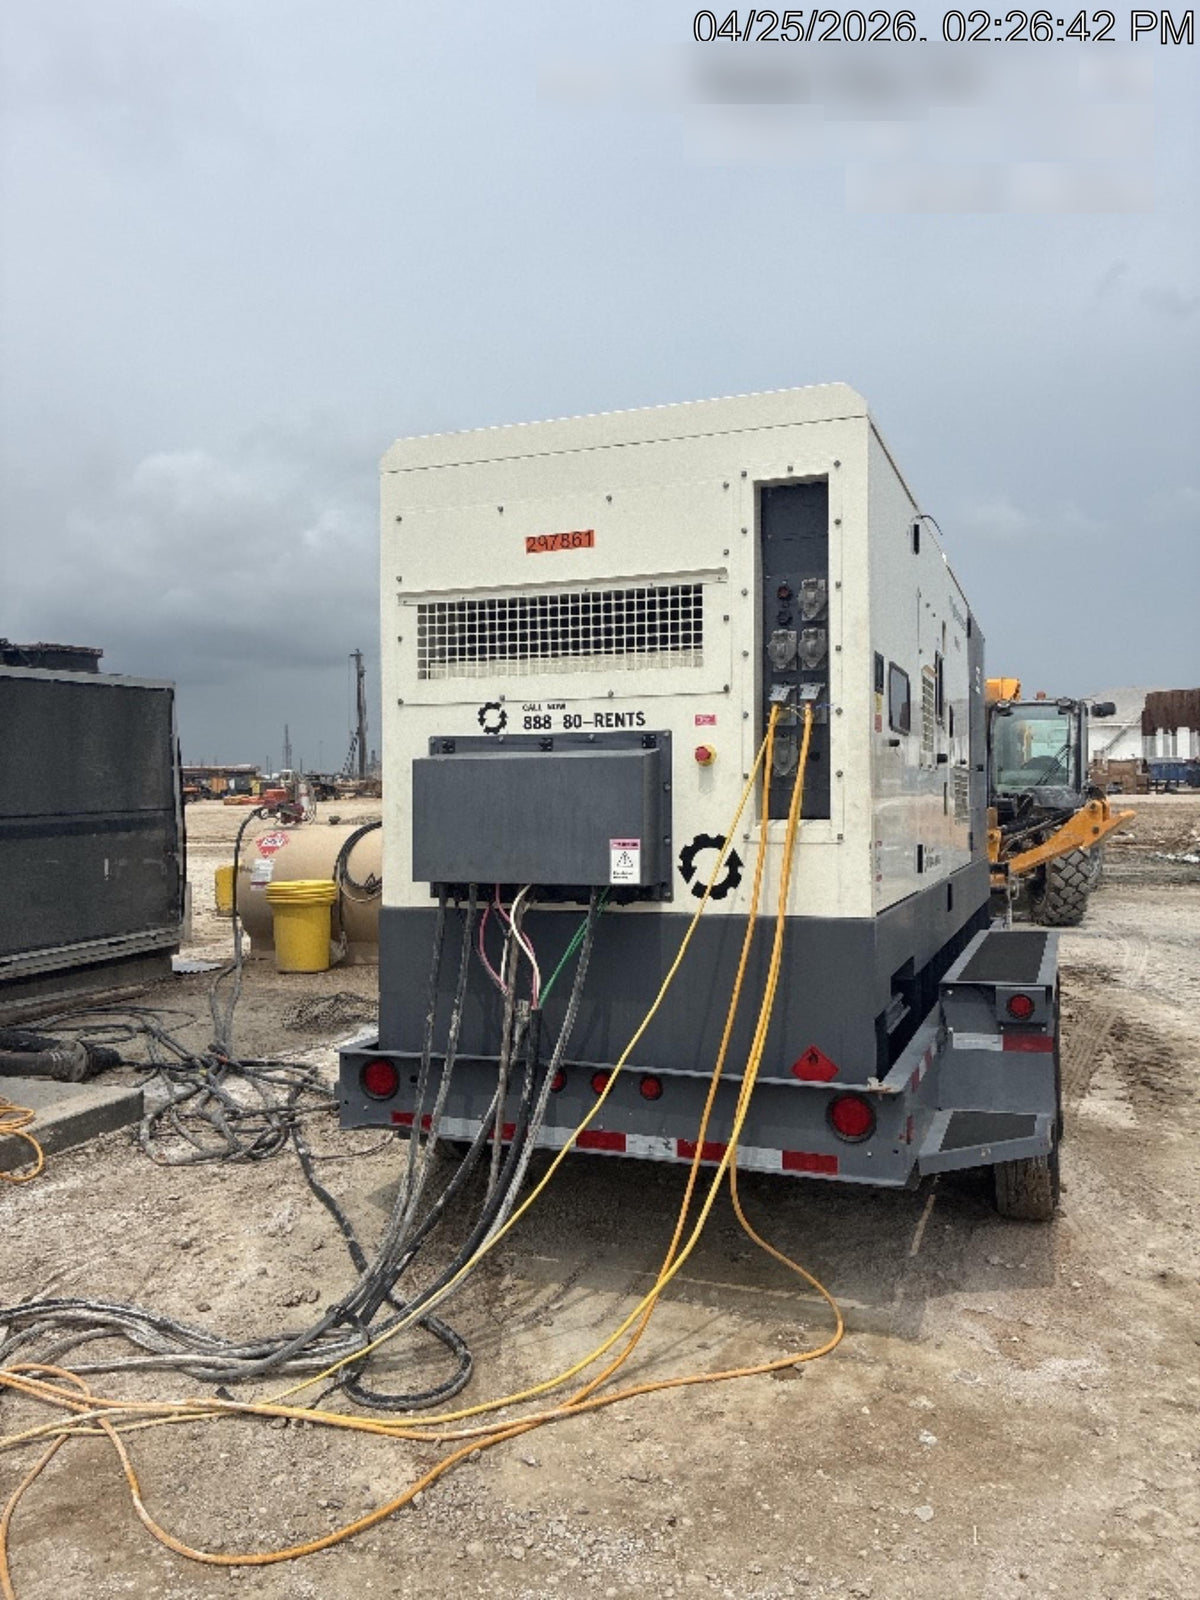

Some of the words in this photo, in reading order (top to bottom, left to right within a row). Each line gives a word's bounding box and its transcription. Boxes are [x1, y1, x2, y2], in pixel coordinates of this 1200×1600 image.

[526, 530, 591, 553] 297861
[522, 703, 542, 712] CALL
[523, 714, 552, 730] 888
[563, 711, 646, 729] 80-RENTS
